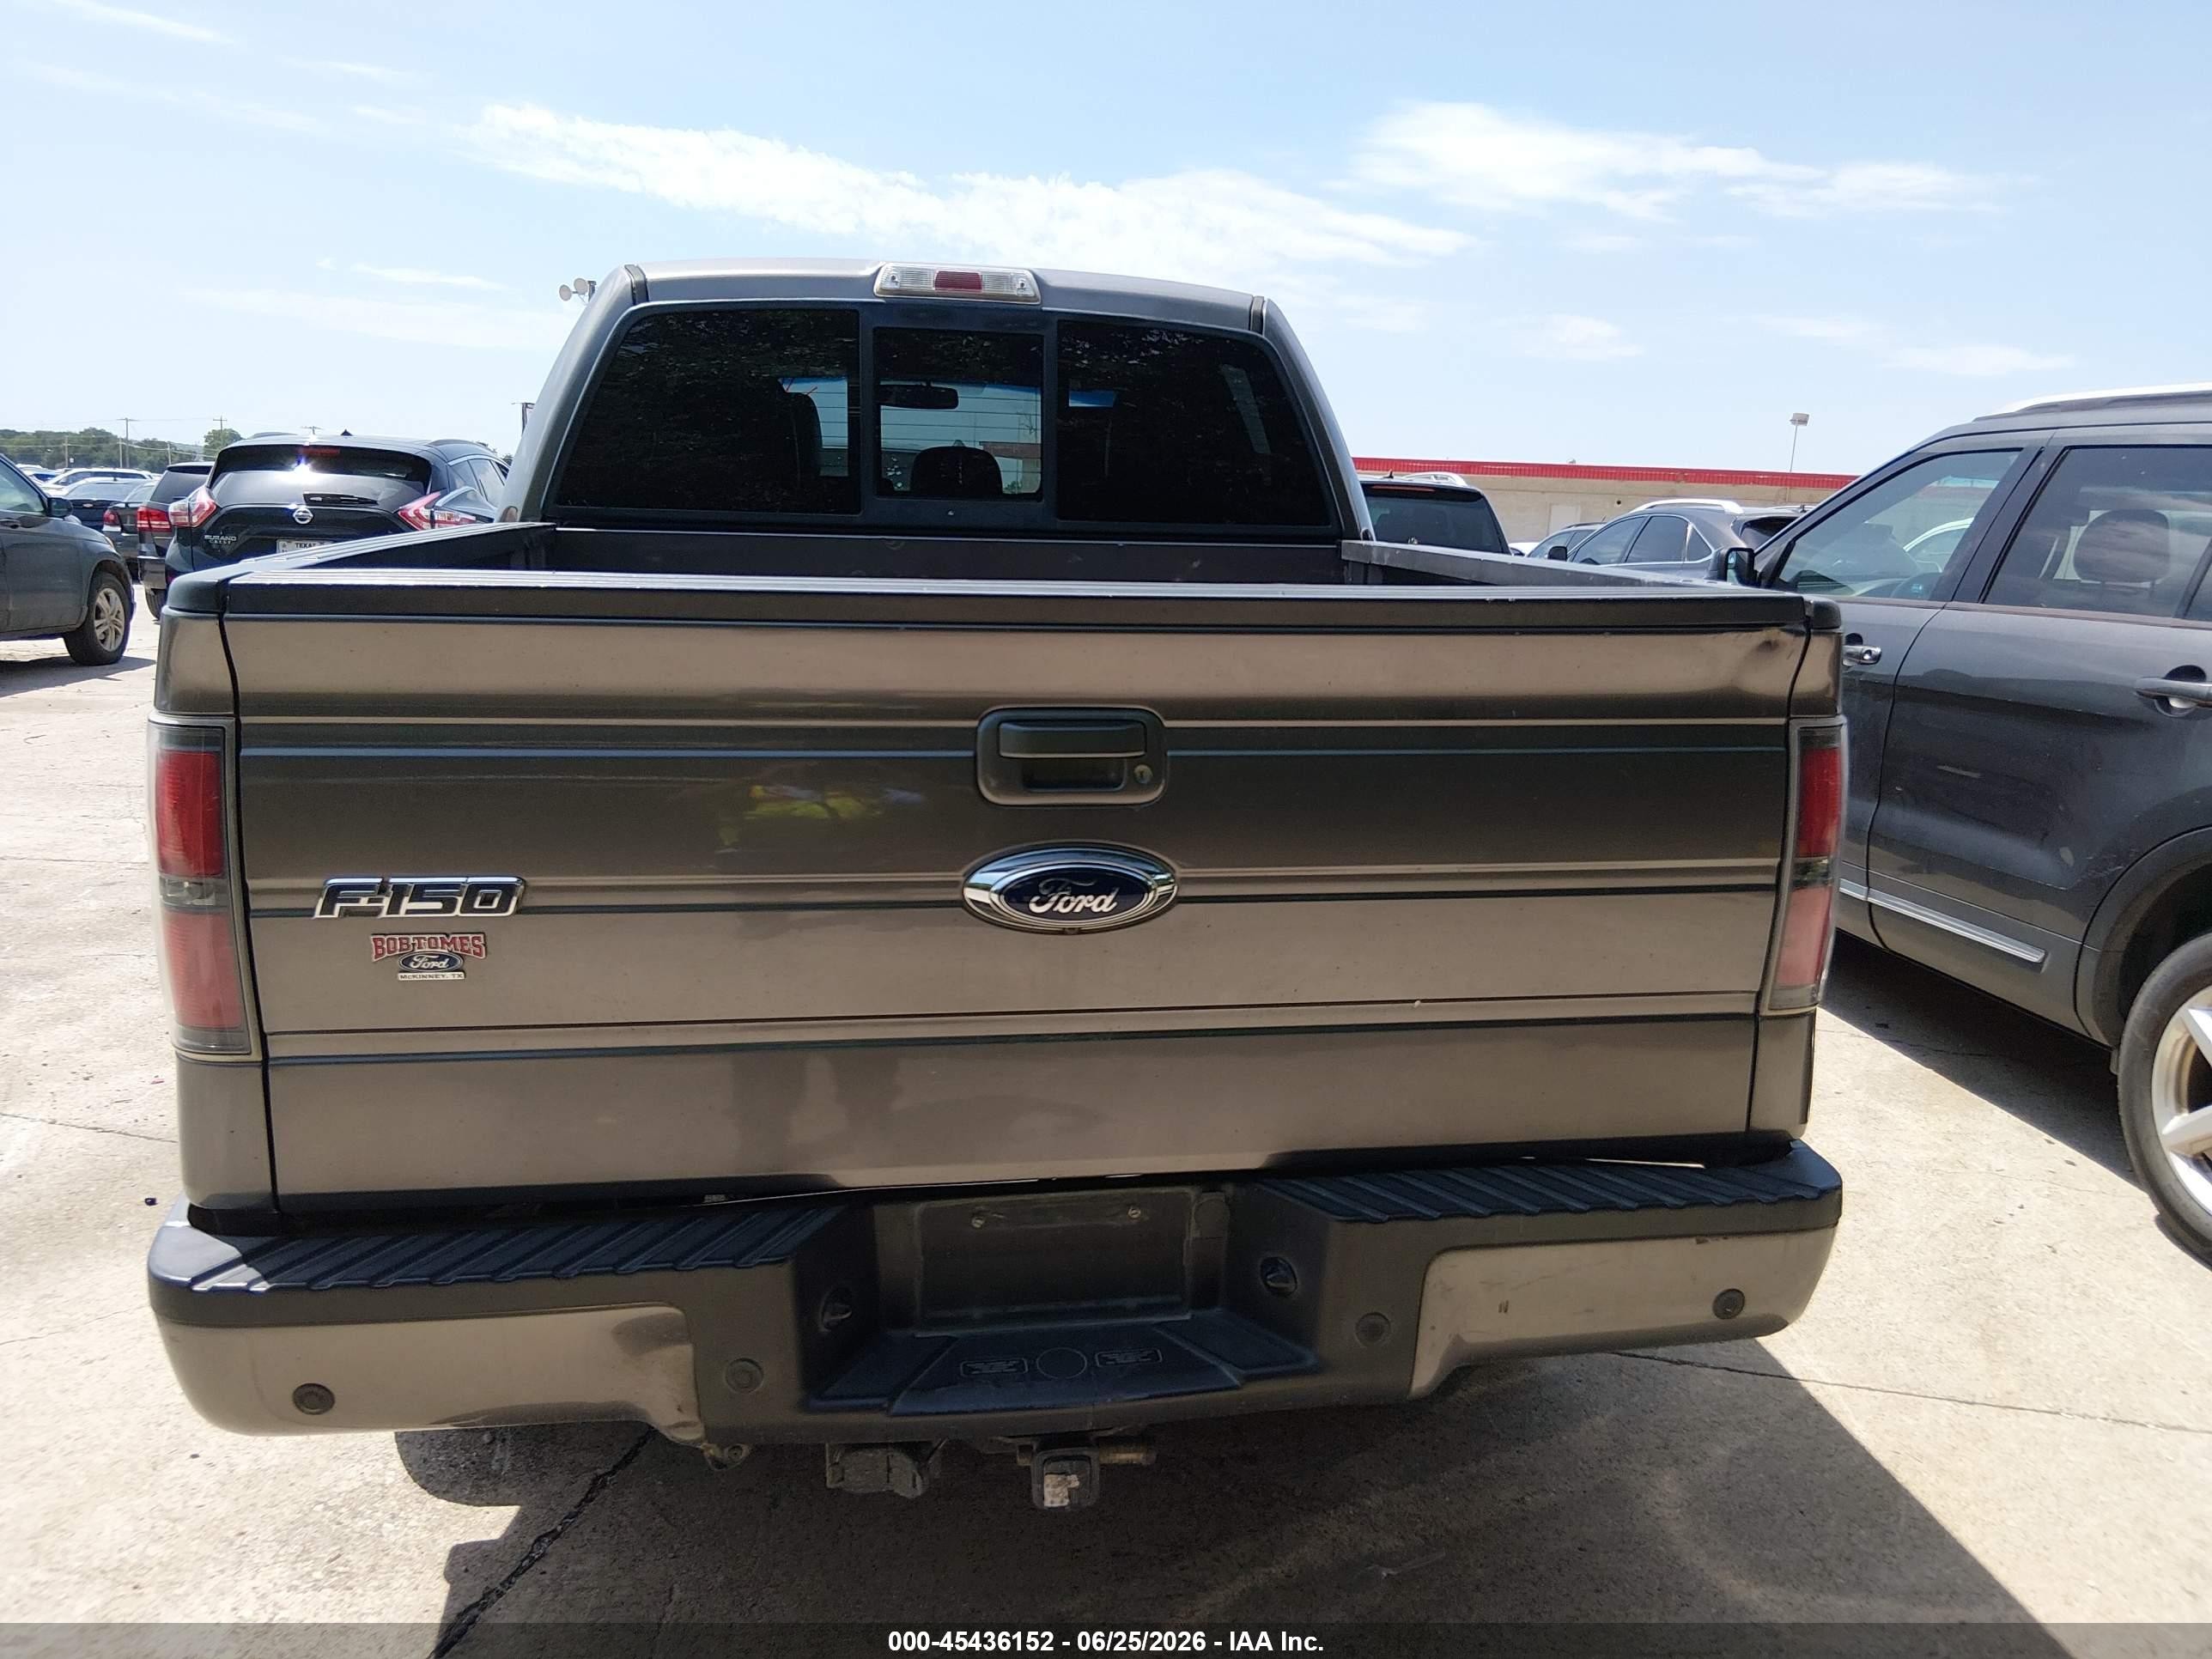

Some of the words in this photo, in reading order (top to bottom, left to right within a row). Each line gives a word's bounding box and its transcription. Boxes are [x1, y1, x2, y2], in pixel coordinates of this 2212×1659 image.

[312, 876, 525, 919] F-150
[1029, 878, 1120, 914] Ford
[371, 935, 412, 961] BOB
[412, 933, 486, 959] TOMES
[410, 954, 449, 969] Ford
